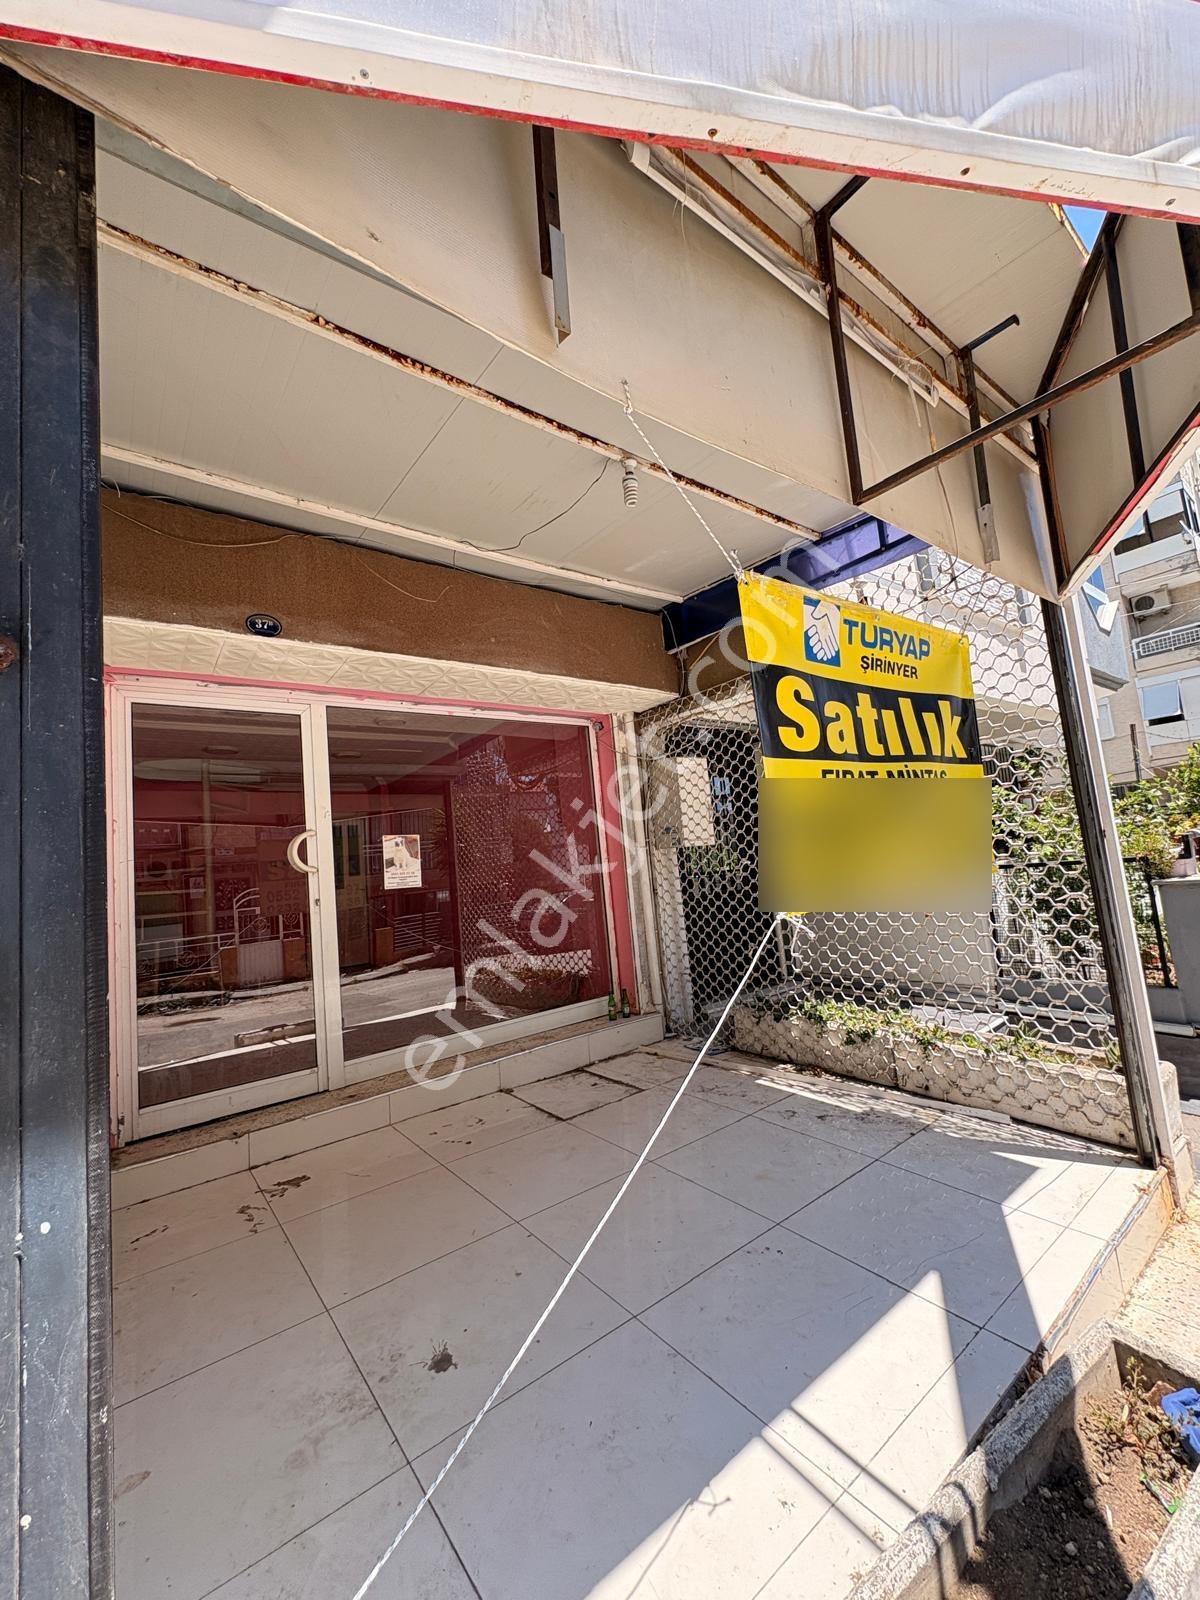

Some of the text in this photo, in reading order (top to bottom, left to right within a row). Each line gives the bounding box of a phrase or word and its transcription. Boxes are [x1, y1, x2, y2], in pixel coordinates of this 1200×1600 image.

[843, 618, 931, 661] TURYAP
[860, 653, 919, 680] ŞİRİNYER
[775, 675, 968, 759] Satılık
